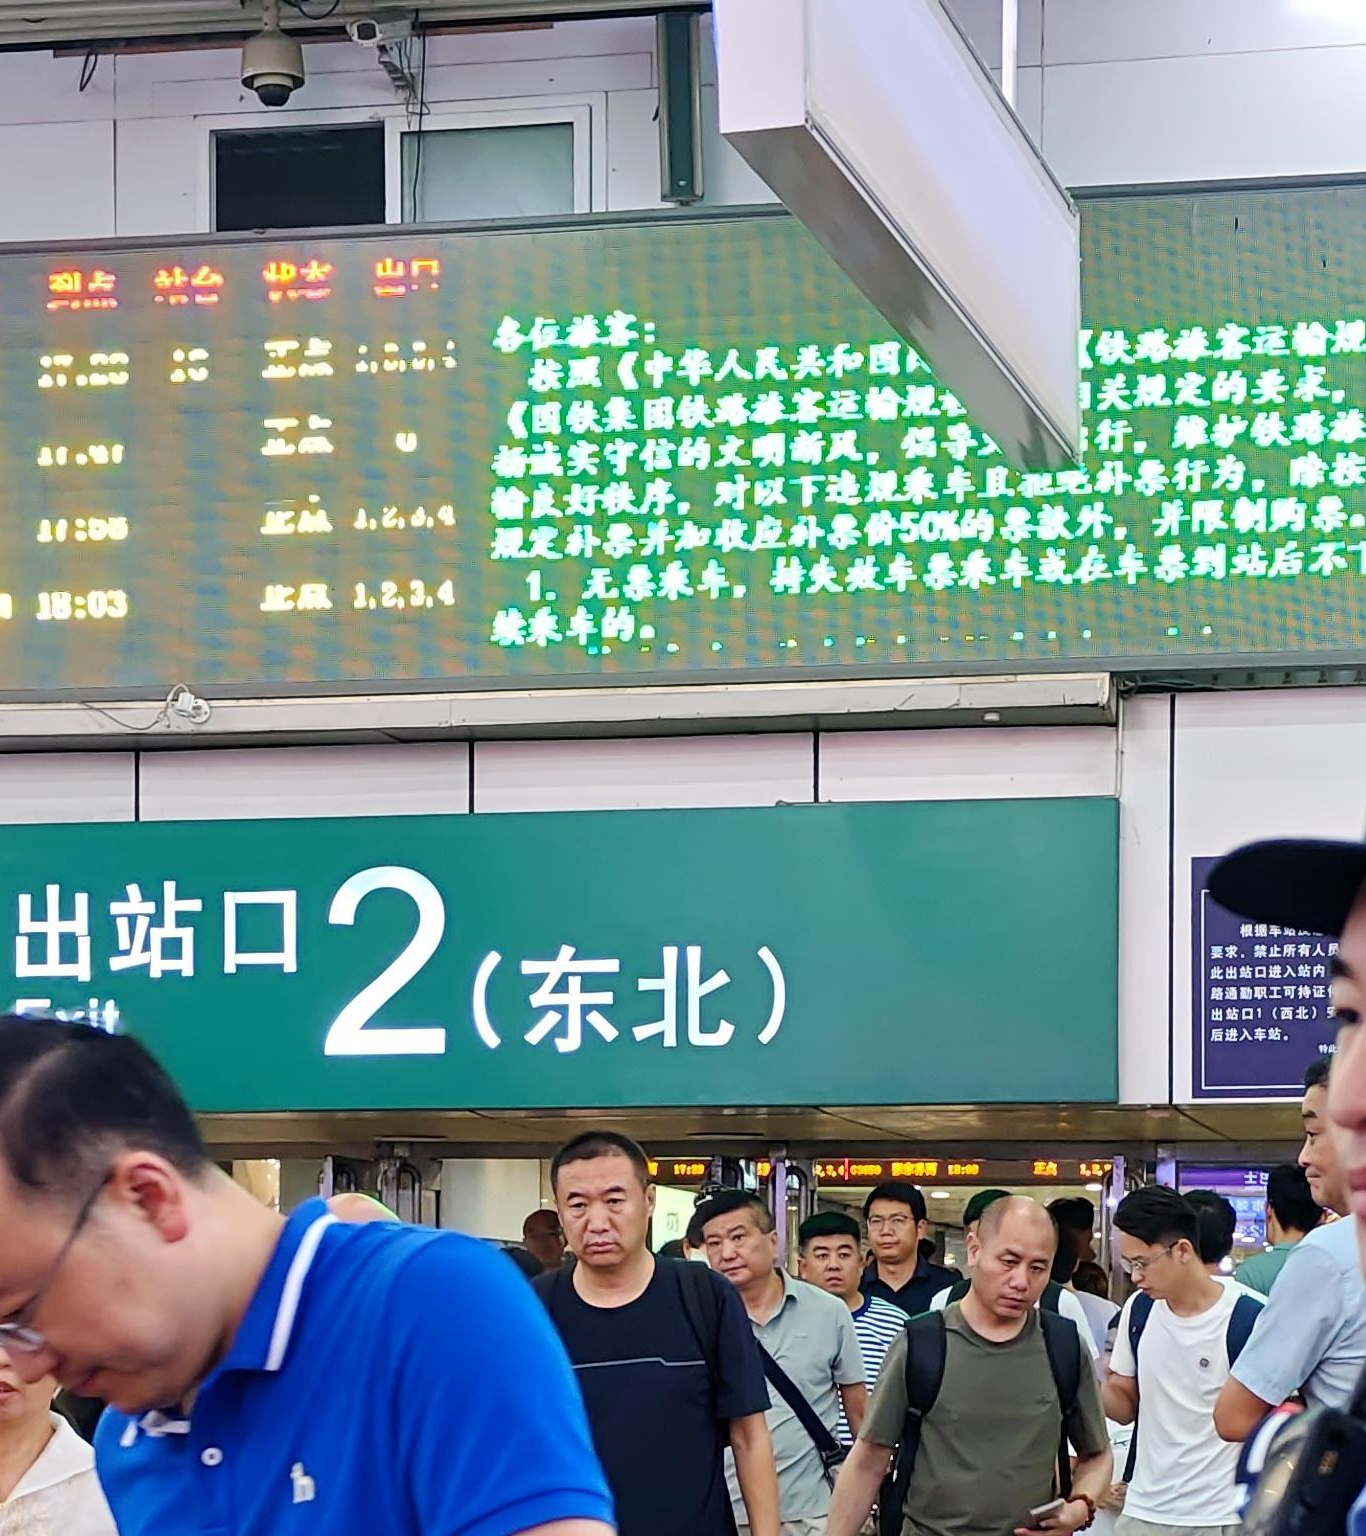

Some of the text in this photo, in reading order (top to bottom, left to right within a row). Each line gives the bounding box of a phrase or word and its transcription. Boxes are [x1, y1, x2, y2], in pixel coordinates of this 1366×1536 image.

[353, 579, 456, 610] 1,2,3,4
[14, 880, 297, 982] 出站口
[323, 865, 446, 1056] 2
[1210, 963, 1326, 980] 此出站口进入站内
